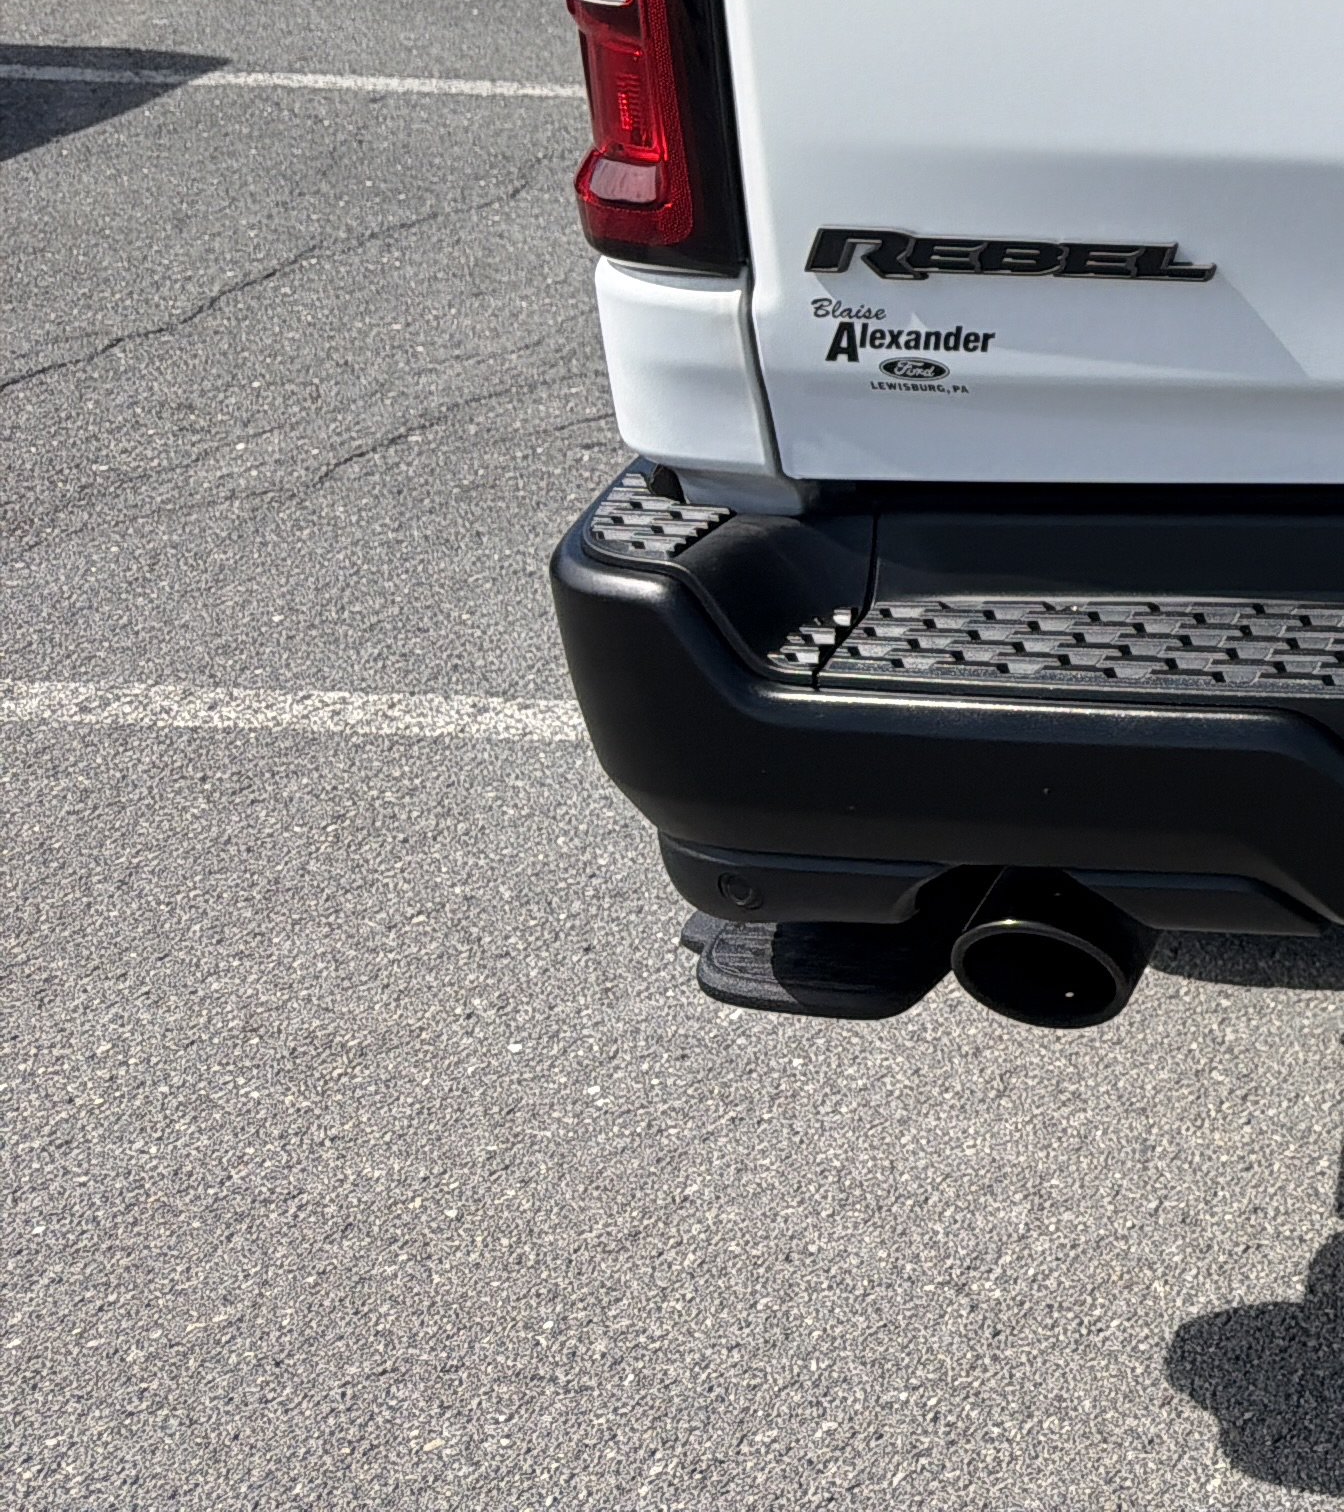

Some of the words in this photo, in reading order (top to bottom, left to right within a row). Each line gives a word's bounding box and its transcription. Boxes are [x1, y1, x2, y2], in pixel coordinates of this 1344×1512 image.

[804, 226, 1217, 282] REBEL
[810, 297, 887, 321] Blaise
[825, 321, 995, 362] Alexander
[952, 384, 969, 394] PA
